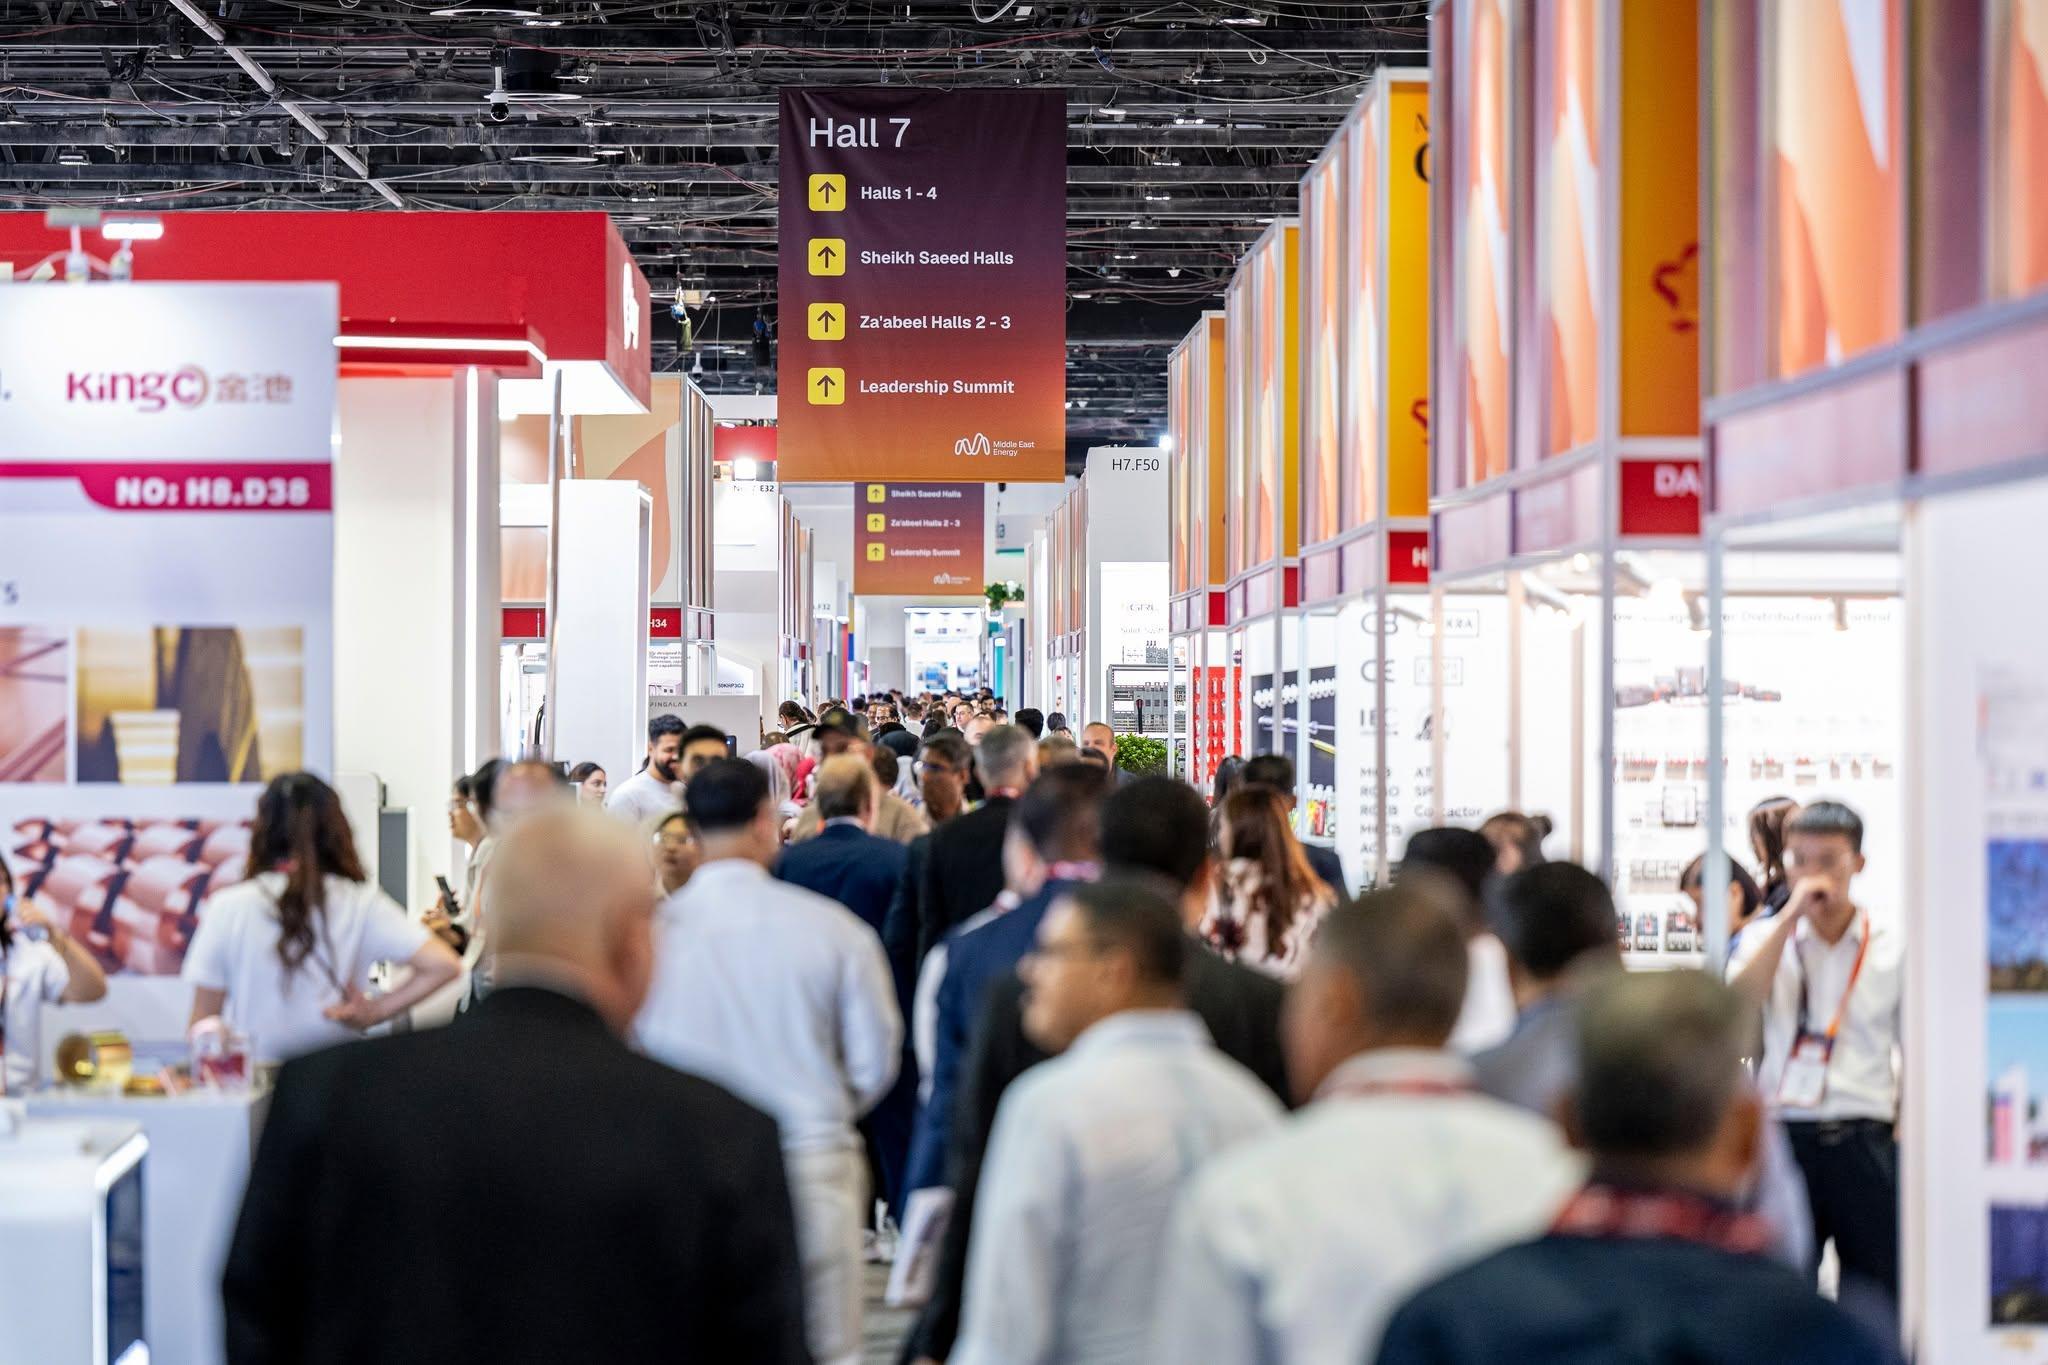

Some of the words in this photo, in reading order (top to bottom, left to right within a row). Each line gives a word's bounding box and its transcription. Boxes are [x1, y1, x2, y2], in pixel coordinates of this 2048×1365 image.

[810, 117, 879, 148] Hall
[889, 118, 911, 148] 7
[860, 186, 902, 200] Halls
[904, 186, 912, 200] 1
[926, 186, 938, 200] 4
[860, 250, 915, 265] Sheikh
[919, 250, 969, 265] Saeed
[973, 251, 1014, 265] Halls
[859, 315, 928, 329] Za'abeel
[931, 315, 972, 329] Halls
[975, 315, 986, 329] 2
[1000, 315, 1011, 329] 3
[860, 379, 949, 396] Leadership
[952, 380, 1015, 394] Summit
[993, 440, 1018, 449] Middle
[1019, 440, 1035, 449] East
[993, 448, 1018, 457] Energy
[1112, 458, 1160, 471] H7.F50
[115, 476, 179, 506] NO:
[891, 490, 917, 498] Sheikh
[918, 490, 941, 498] Saeed
[942, 490, 962, 498] Halls
[923, 519, 942, 527] Halls
[943, 519, 949, 527] 2
[890, 548, 932, 558] Leadership
[932, 548, 961, 557] Summit
